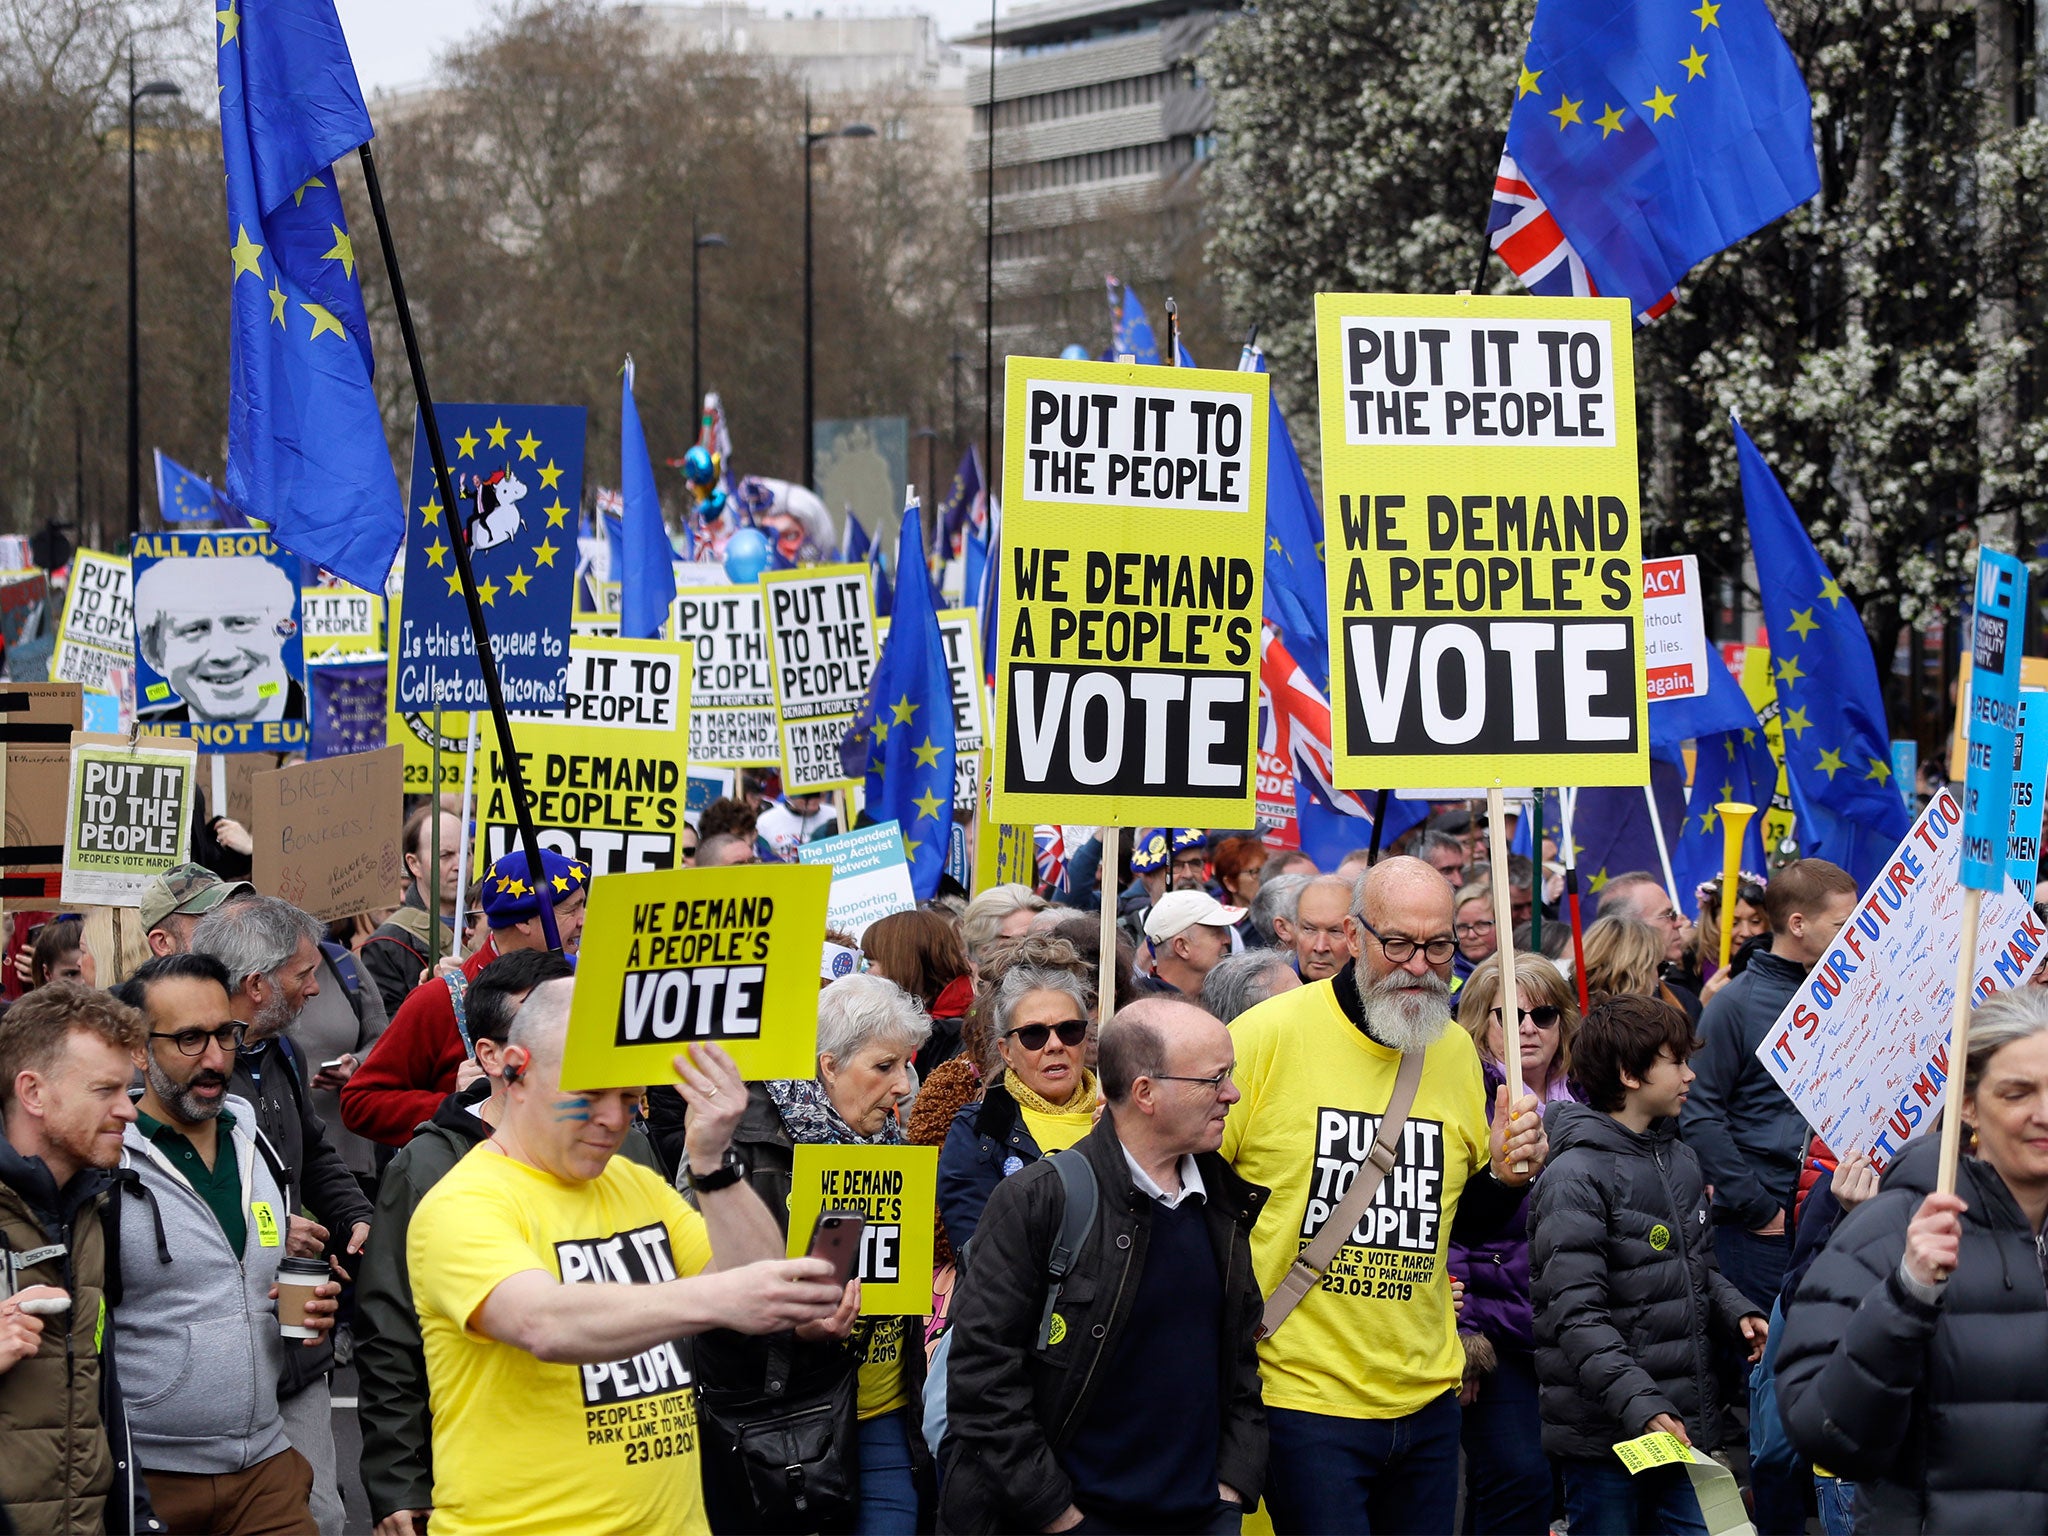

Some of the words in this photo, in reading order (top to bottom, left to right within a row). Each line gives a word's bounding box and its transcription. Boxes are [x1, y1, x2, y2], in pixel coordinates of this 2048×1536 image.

[1348, 327, 1450, 387] PUT
[1470, 329, 1518, 387] IT
[1538, 331, 1600, 389] TO
[1032, 390, 1117, 449] PUT
[1133, 397, 1175, 452] IT
[1191, 400, 1242, 457] TO
[1349, 391, 1430, 436] THE
[1445, 393, 1604, 437] PEOPLE
[1029, 450, 1095, 495] THE
[1108, 457, 1241, 502] PEOPLE
[1340, 494, 1407, 551] WE
[1426, 495, 1628, 552] DEMAND
[133, 536, 188, 558] ALL
[194, 534, 293, 557] ABOU
[82, 562, 126, 594] PUT
[1014, 547, 1069, 602] WE
[1086, 551, 1254, 610] DEMAND
[1343, 557, 1373, 611] A
[1389, 556, 1631, 611] PEOPLE'S
[1643, 568, 1682, 595] ACY
[79, 587, 101, 611] TO
[110, 595, 134, 619] TH
[325, 600, 341, 617] IT
[350, 600, 367, 616] TO
[681, 601, 739, 631] PUT
[773, 586, 826, 627] PUT
[836, 582, 861, 620] IT
[72, 609, 134, 641] PEOPL
[316, 618, 368, 632] PEOPLE
[1010, 607, 1036, 657] A
[1051, 607, 1252, 666] PEOPLE'S
[1644, 612, 1682, 629] ithout
[403, 620, 421, 658] Is
[425, 621, 458, 657] this
[461, 627, 481, 657] th
[490, 631, 537, 662] queue
[541, 627, 562, 656] to
[725, 633, 769, 661] TH
[778, 628, 811, 664] TO
[817, 623, 868, 660] THE
[1660, 637, 1684, 655] lies.
[80, 660, 107, 677] DEMA
[401, 665, 462, 703] Collect
[585, 657, 617, 691] IT
[630, 660, 671, 695] TO
[692, 664, 772, 689] EOPL
[782, 660, 870, 698] PEOPLE
[1348, 622, 1630, 745] VOTE
[1647, 672, 1694, 697] again.
[564, 693, 670, 724] PEOPLE
[782, 704, 813, 719] DEMAND
[192, 724, 253, 746] NOT
[708, 729, 768, 745] DEMAND
[791, 725, 807, 745] I'M
[811, 722, 851, 743] MARC
[1014, 670, 1245, 787] VOTE
[749, 745, 780, 758] VOTE
[794, 747, 810, 765] TO
[815, 742, 841, 763] DEM
[86, 762, 144, 796] PUT
[153, 767, 182, 798] IT
[280, 761, 378, 806] BREXIT
[490, 751, 533, 785] WE
[546, 753, 679, 793] DEMAND
[85, 794, 117, 824] TO
[126, 797, 179, 828] THE
[487, 788, 505, 819] A
[526, 791, 677, 828] PEOPLE'S
[1915, 794, 1960, 852] TOO
[81, 823, 177, 855] PEOPLE
[801, 847, 823, 860] The
[825, 826, 898, 853] Independent
[810, 852, 847, 867] Group
[850, 840, 893, 859] Activist
[78, 854, 120, 865] PEOPLE'S
[122, 857, 144, 867] VOTE
[146, 858, 175, 868] MARCH
[832, 855, 881, 876] Network
[633, 903, 665, 934] WE
[673, 897, 774, 931] DEMAND
[828, 892, 898, 917] Supporting
[1844, 845, 1923, 961] FUTURE
[627, 939, 640, 967] A
[651, 931, 771, 965] PEOPLE'S
[1993, 911, 2046, 989] MARK
[1811, 949, 1858, 1010] OUR
[624, 967, 764, 1041] VOTE
[1771, 1003, 1819, 1074] IT'S
[1912, 1027, 1953, 1108] MAK
[1888, 1094, 1922, 1141] US
[1404, 1120, 1439, 1167] IT
[821, 1170, 839, 1195] WE
[844, 1170, 903, 1195] DEMAND
[1317, 1157, 1361, 1201] TO
[832, 1197, 901, 1221] PEOPLE'S
[1303, 1199, 1438, 1250] POPLE
[26, 1248, 57, 1262] osprey
[629, 1228, 676, 1284] IT
[858, 1226, 898, 1278] TE
[1369, 1252, 1398, 1267] VOTE
[1402, 1256, 1435, 1270] MARCH
[1322, 1274, 1413, 1301] 23.03.2019
[1330, 1263, 1358, 1276] LANE
[1363, 1266, 1376, 1278] TO
[1380, 1268, 1432, 1284] PARLIAMENT
[586, 1401, 658, 1428] PEOPLE'S
[660, 1395, 686, 1416] VOTE
[587, 1426, 624, 1446] PARK
[628, 1420, 658, 1440] LANE
[661, 1418, 672, 1433] TO
